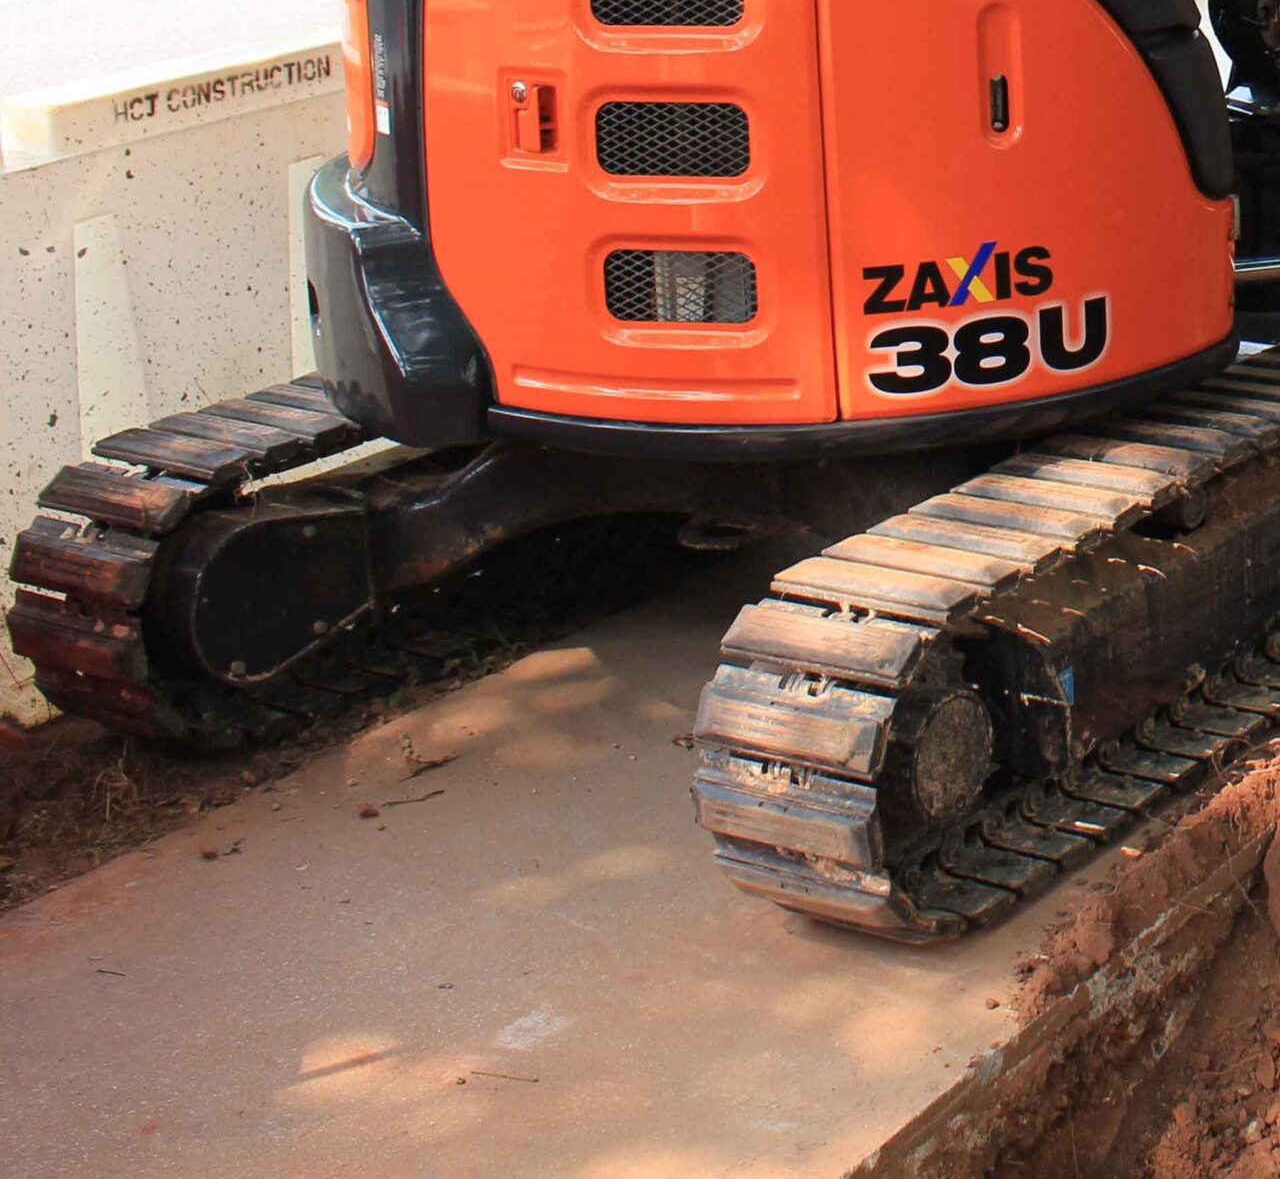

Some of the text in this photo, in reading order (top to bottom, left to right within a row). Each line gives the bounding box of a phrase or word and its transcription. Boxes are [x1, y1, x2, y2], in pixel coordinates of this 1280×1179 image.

[112, 91, 159, 121] HCJ
[167, 55, 331, 113] CONSTRUCTION
[862, 241, 1054, 315] ZAXIS
[868, 296, 1107, 394] 38U
